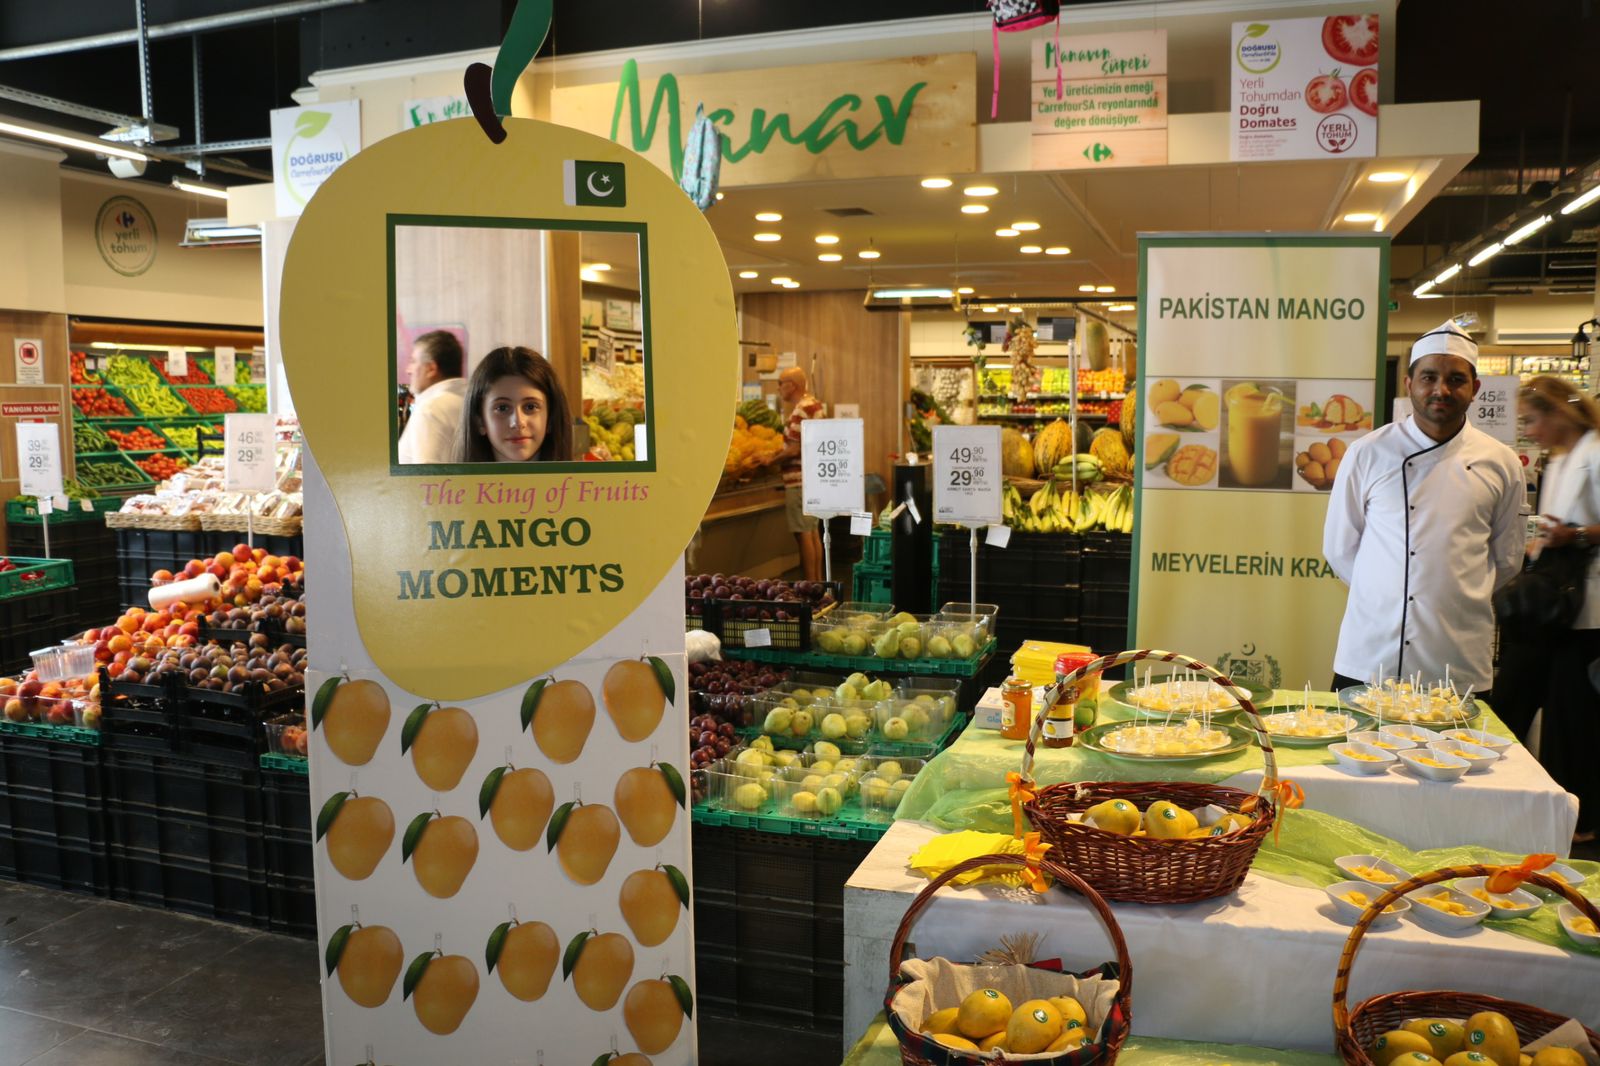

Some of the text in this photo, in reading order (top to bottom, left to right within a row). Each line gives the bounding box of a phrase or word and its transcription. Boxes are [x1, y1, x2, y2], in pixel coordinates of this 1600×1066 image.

[1043, 80, 1154, 97] Yer üreticimizin emeği
[1240, 77, 1264, 89] Yerli
[1240, 88, 1301, 103] Tohumdan
[1037, 95, 1159, 114] CarrefourSA reyonlarında
[1240, 104, 1279, 116] Doğru
[609, 58, 928, 184] Manav
[1054, 113, 1141, 129] değere dönüşüyor.
[1240, 118, 1296, 129] Domates
[1321, 121, 1352, 132] YERLİ
[1321, 131, 1352, 139] TOHUM
[290, 152, 343, 166] DOĞRUSU
[115, 228, 140, 243] yerli
[111, 242, 148, 254] tohum
[1159, 292, 1365, 321] PAKİSTAN MANGO
[3, 405, 32, 413] YANGIN
[1478, 407, 1495, 419] 34
[420, 477, 649, 514] The King of Fruits
[427, 516, 591, 551] MANGO
[1151, 552, 1339, 579] MEYVELERİN KRA
[396, 562, 624, 600] MOMENTS
